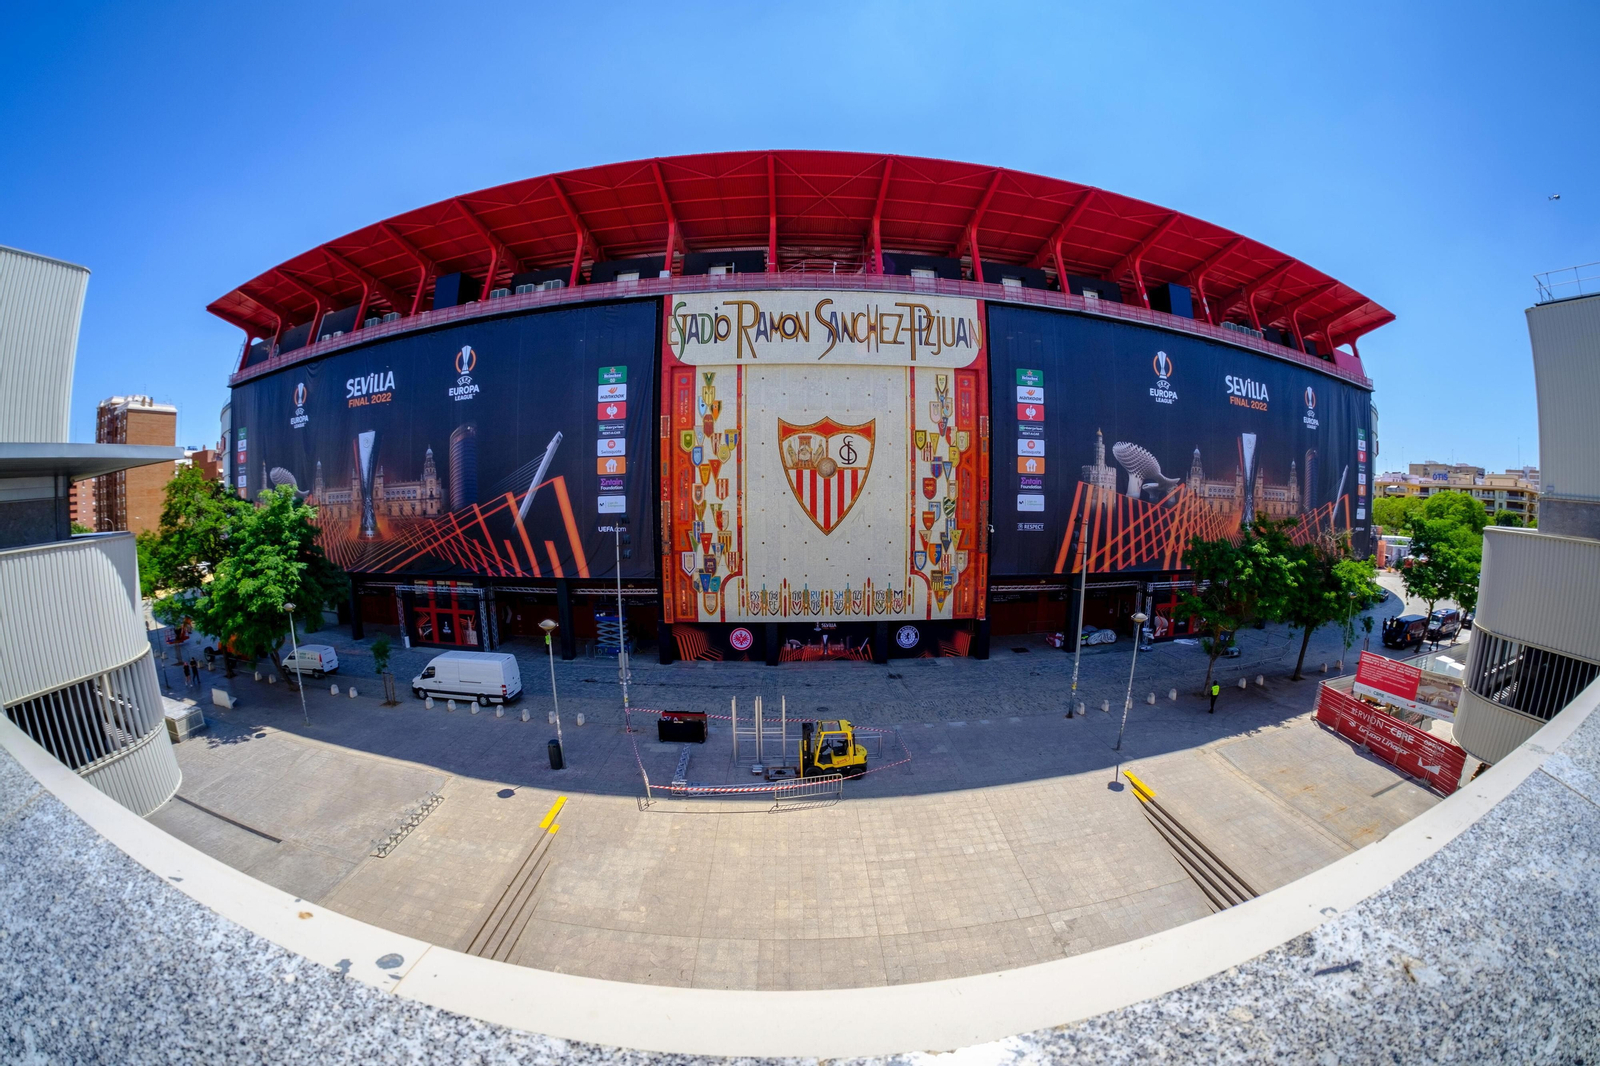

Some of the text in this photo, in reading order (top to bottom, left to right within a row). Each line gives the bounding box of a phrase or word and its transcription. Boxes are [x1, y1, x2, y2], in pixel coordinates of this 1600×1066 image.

[456, 376, 472, 386] UEFA
[1156, 380, 1171, 390] UEFA
[448, 384, 480, 396] EUROPA
[1150, 388, 1178, 399] EUROPA
[348, 392, 392, 408] FINAL 2022
[1230, 396, 1268, 411] FINAL 2022
[290, 415, 309, 425] EUROPA
[1303, 416, 1319, 426] EUROPA
[1359, 725, 1381, 741] Grupo
[1390, 727, 1415, 744] CBRE
